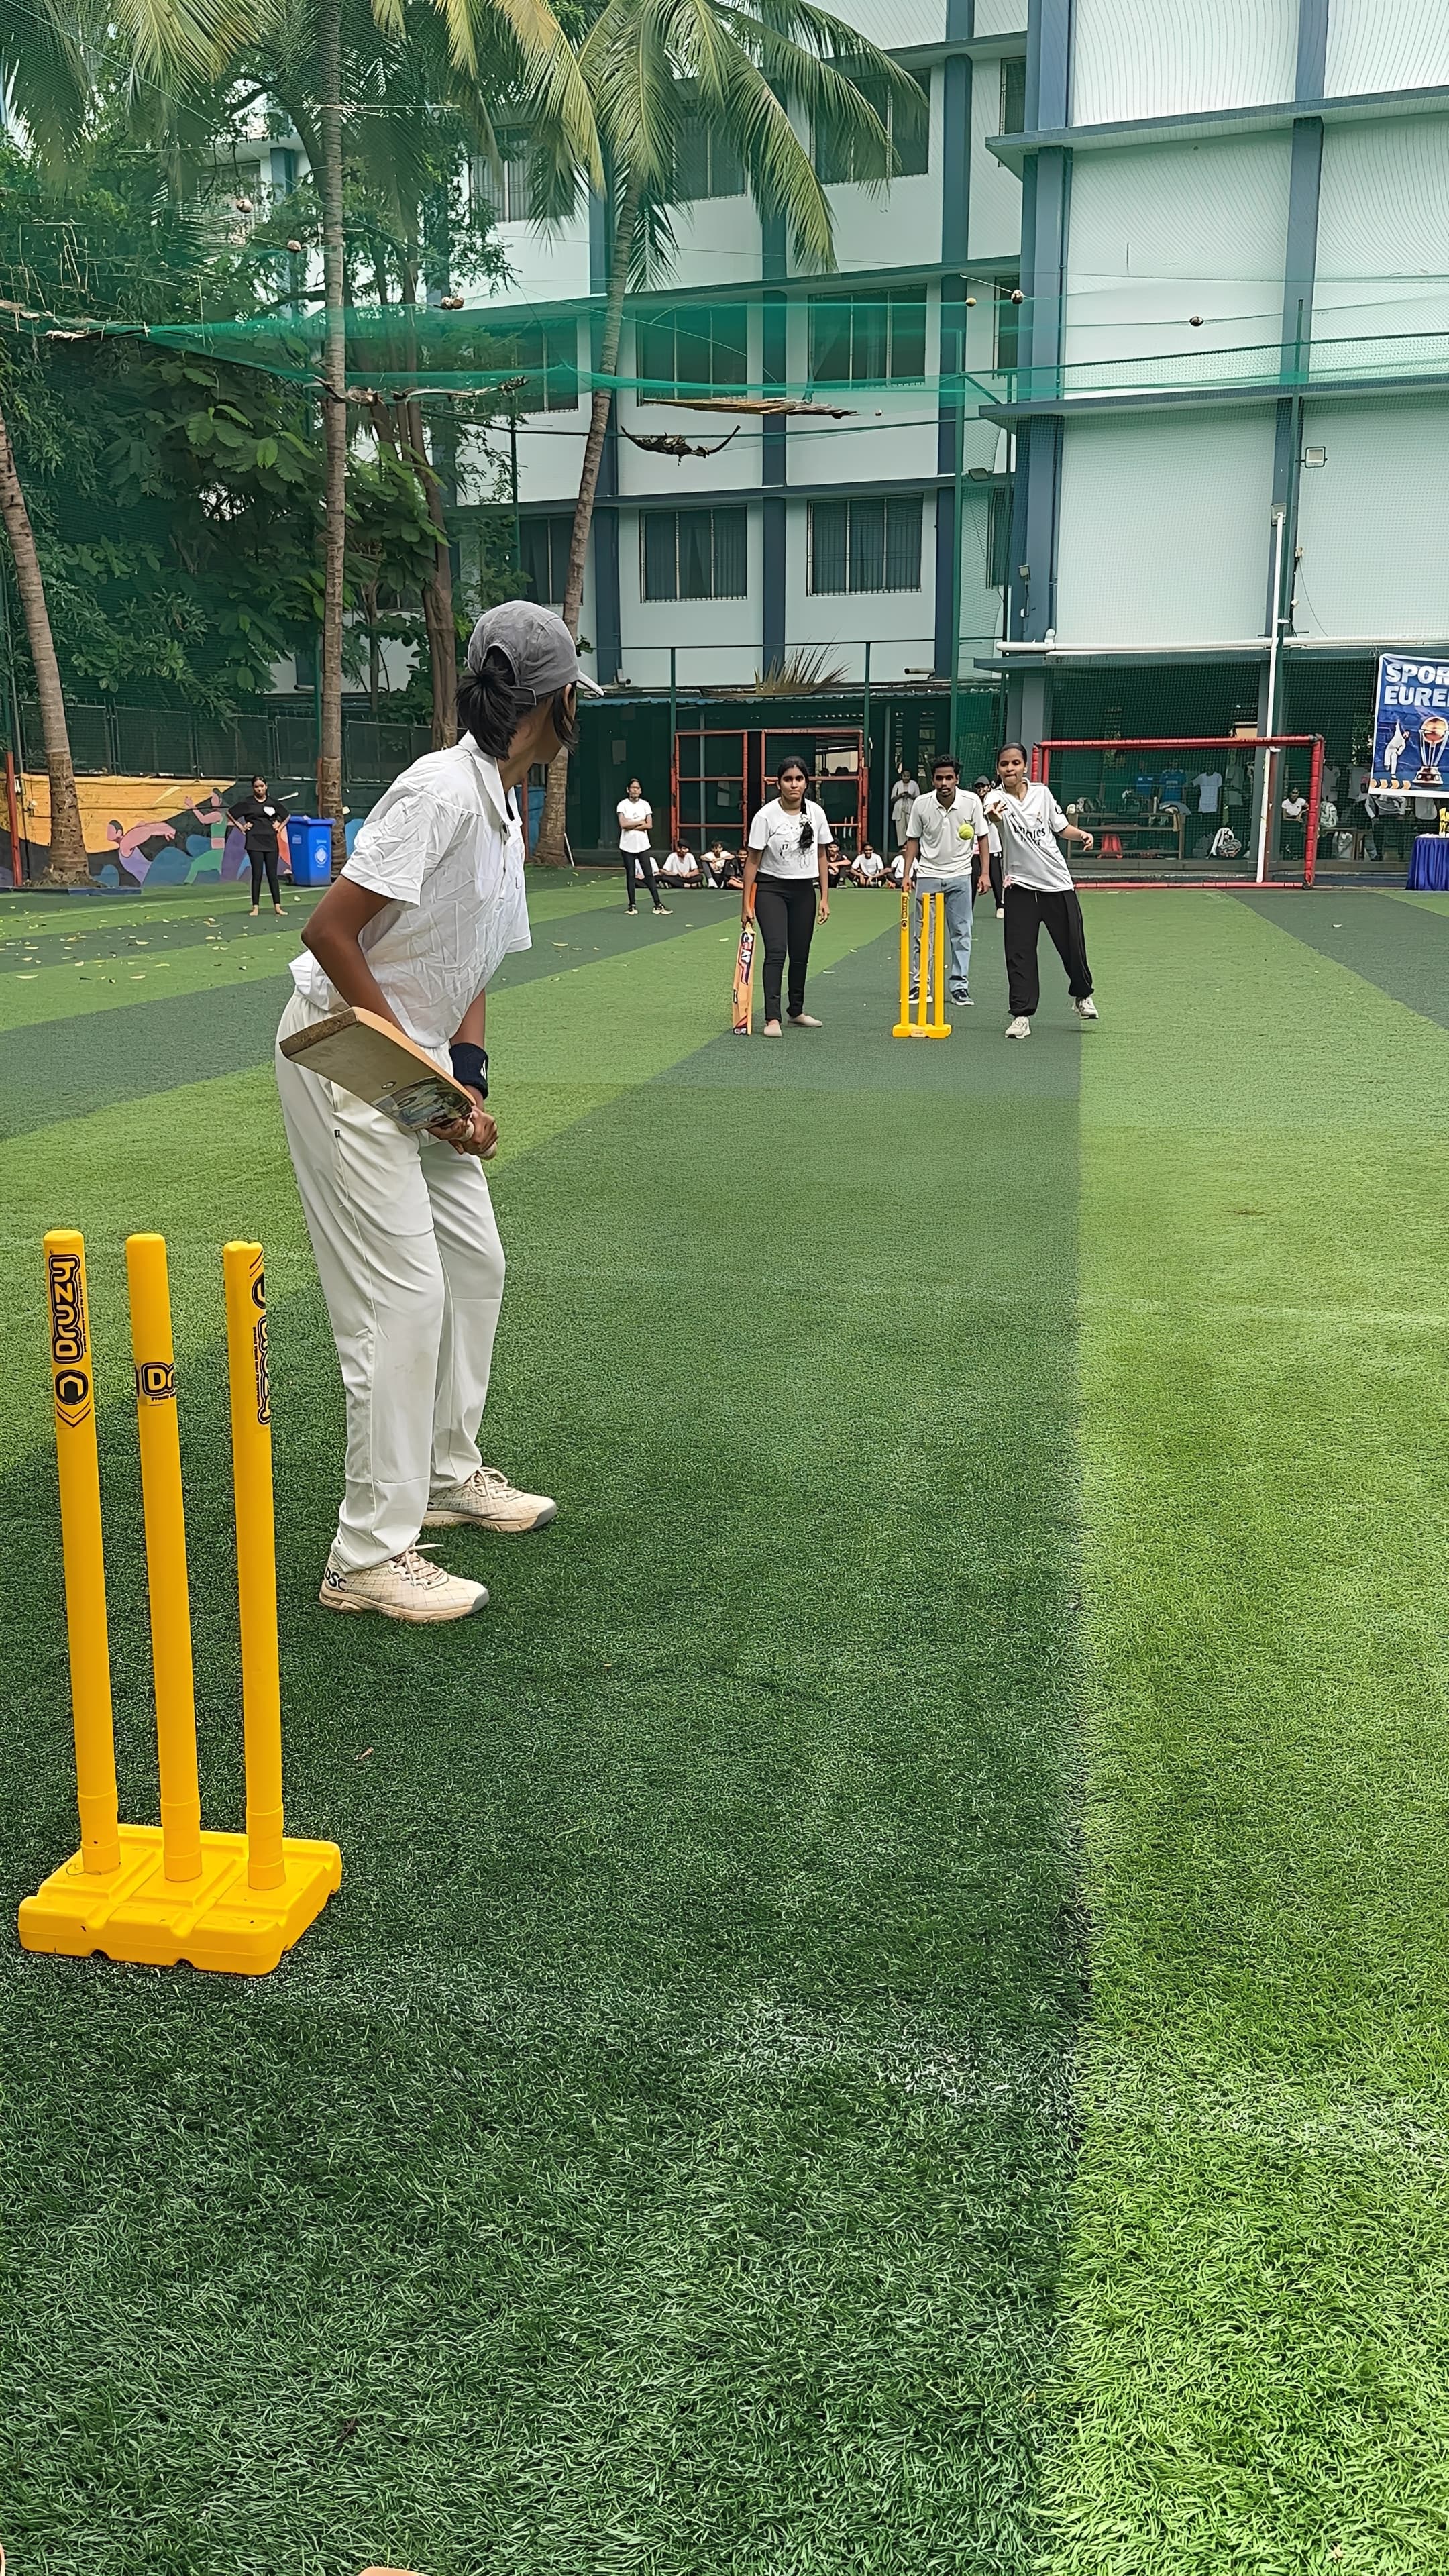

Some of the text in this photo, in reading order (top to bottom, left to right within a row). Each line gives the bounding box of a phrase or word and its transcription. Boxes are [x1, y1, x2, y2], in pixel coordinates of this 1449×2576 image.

[1384, 686, 1449, 707] EURE
[51, 1258, 80, 1360] Druzy
[325, 1566, 347, 1591] DSC
